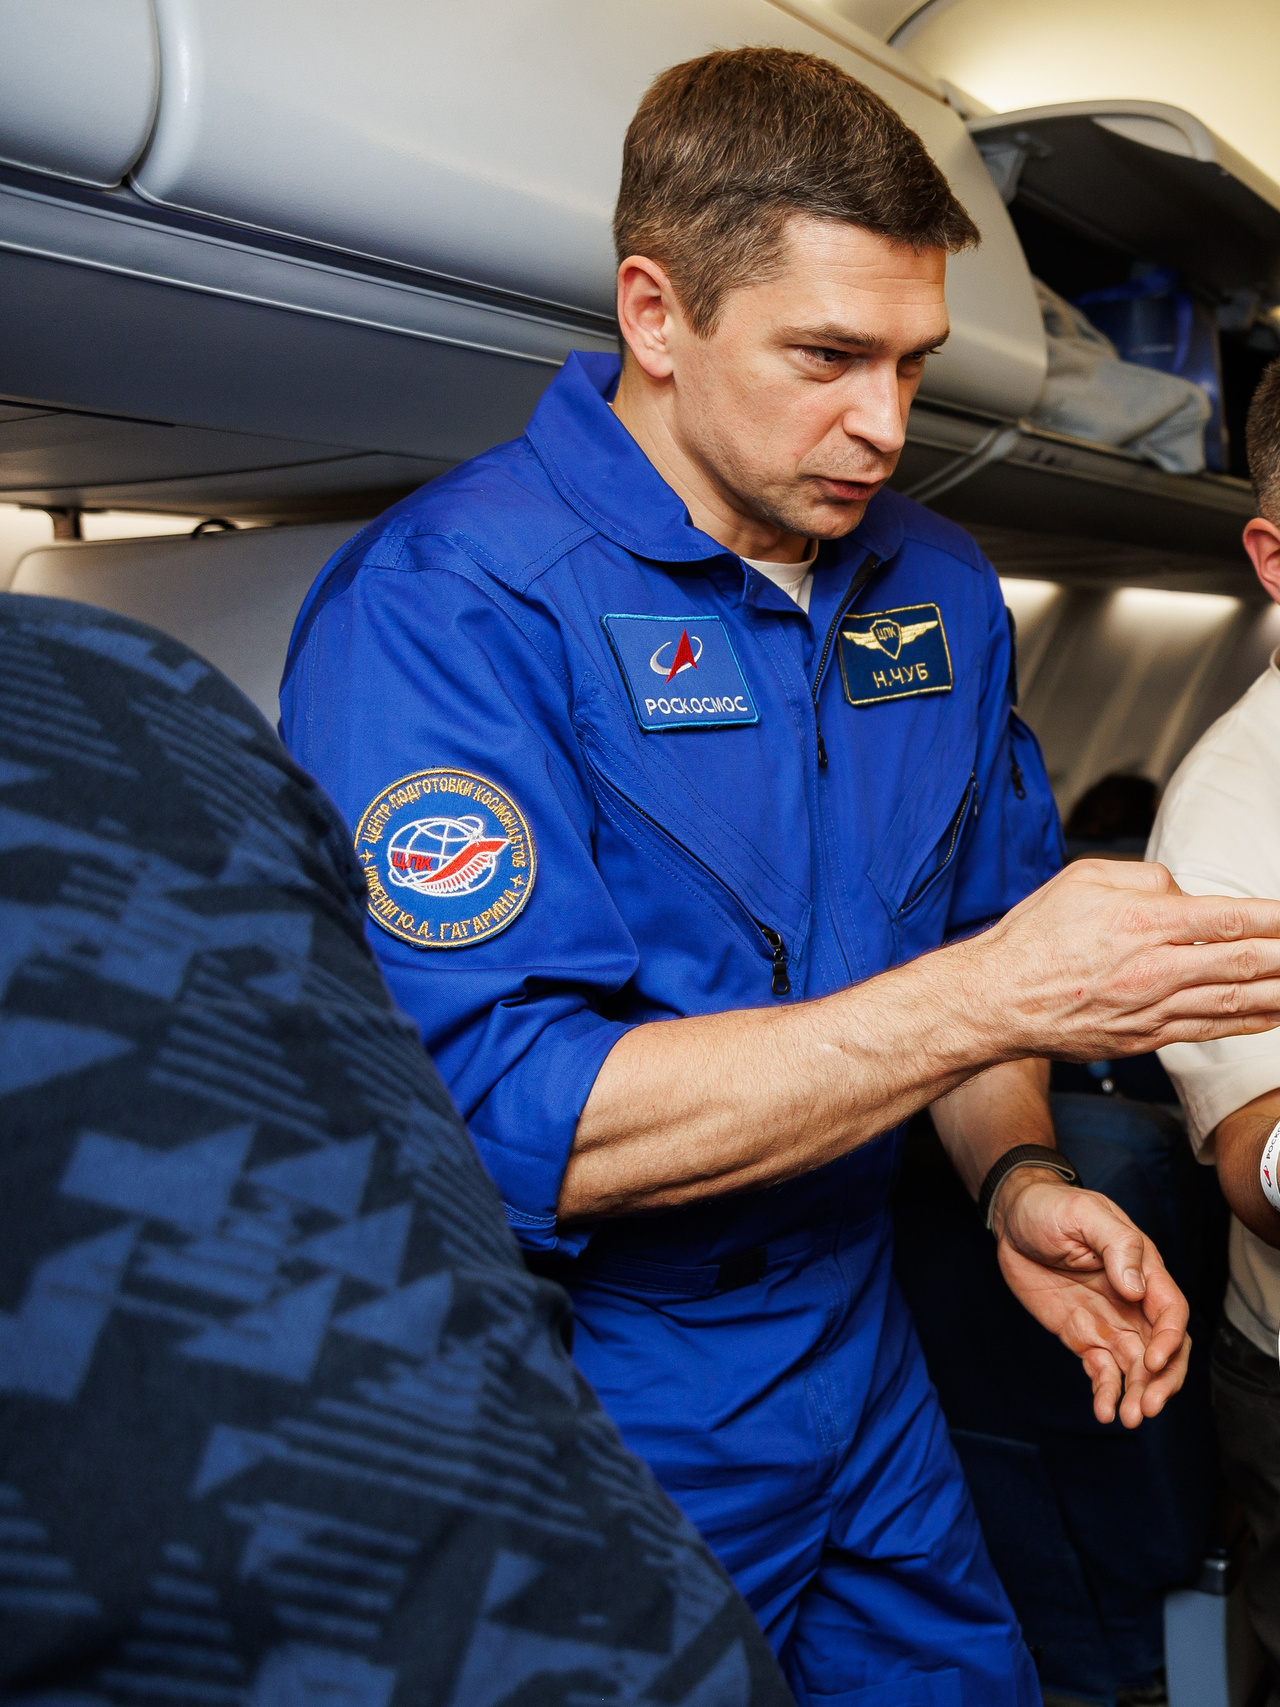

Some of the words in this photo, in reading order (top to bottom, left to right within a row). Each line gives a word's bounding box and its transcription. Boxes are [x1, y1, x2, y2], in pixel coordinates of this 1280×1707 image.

[875, 626, 898, 641] ЦПК
[644, 695, 748, 717] РОСКОСМОС
[361, 804, 393, 844] ЦЕНТР
[388, 777, 475, 811] ПОДГОТОВКИ
[473, 784, 527, 869] КОСМОНАВТОВ
[391, 851, 434, 872] ЦПК
[363, 864, 398, 920] ИМЕНИ
[439, 888, 520, 940] ГАГАРИНА
